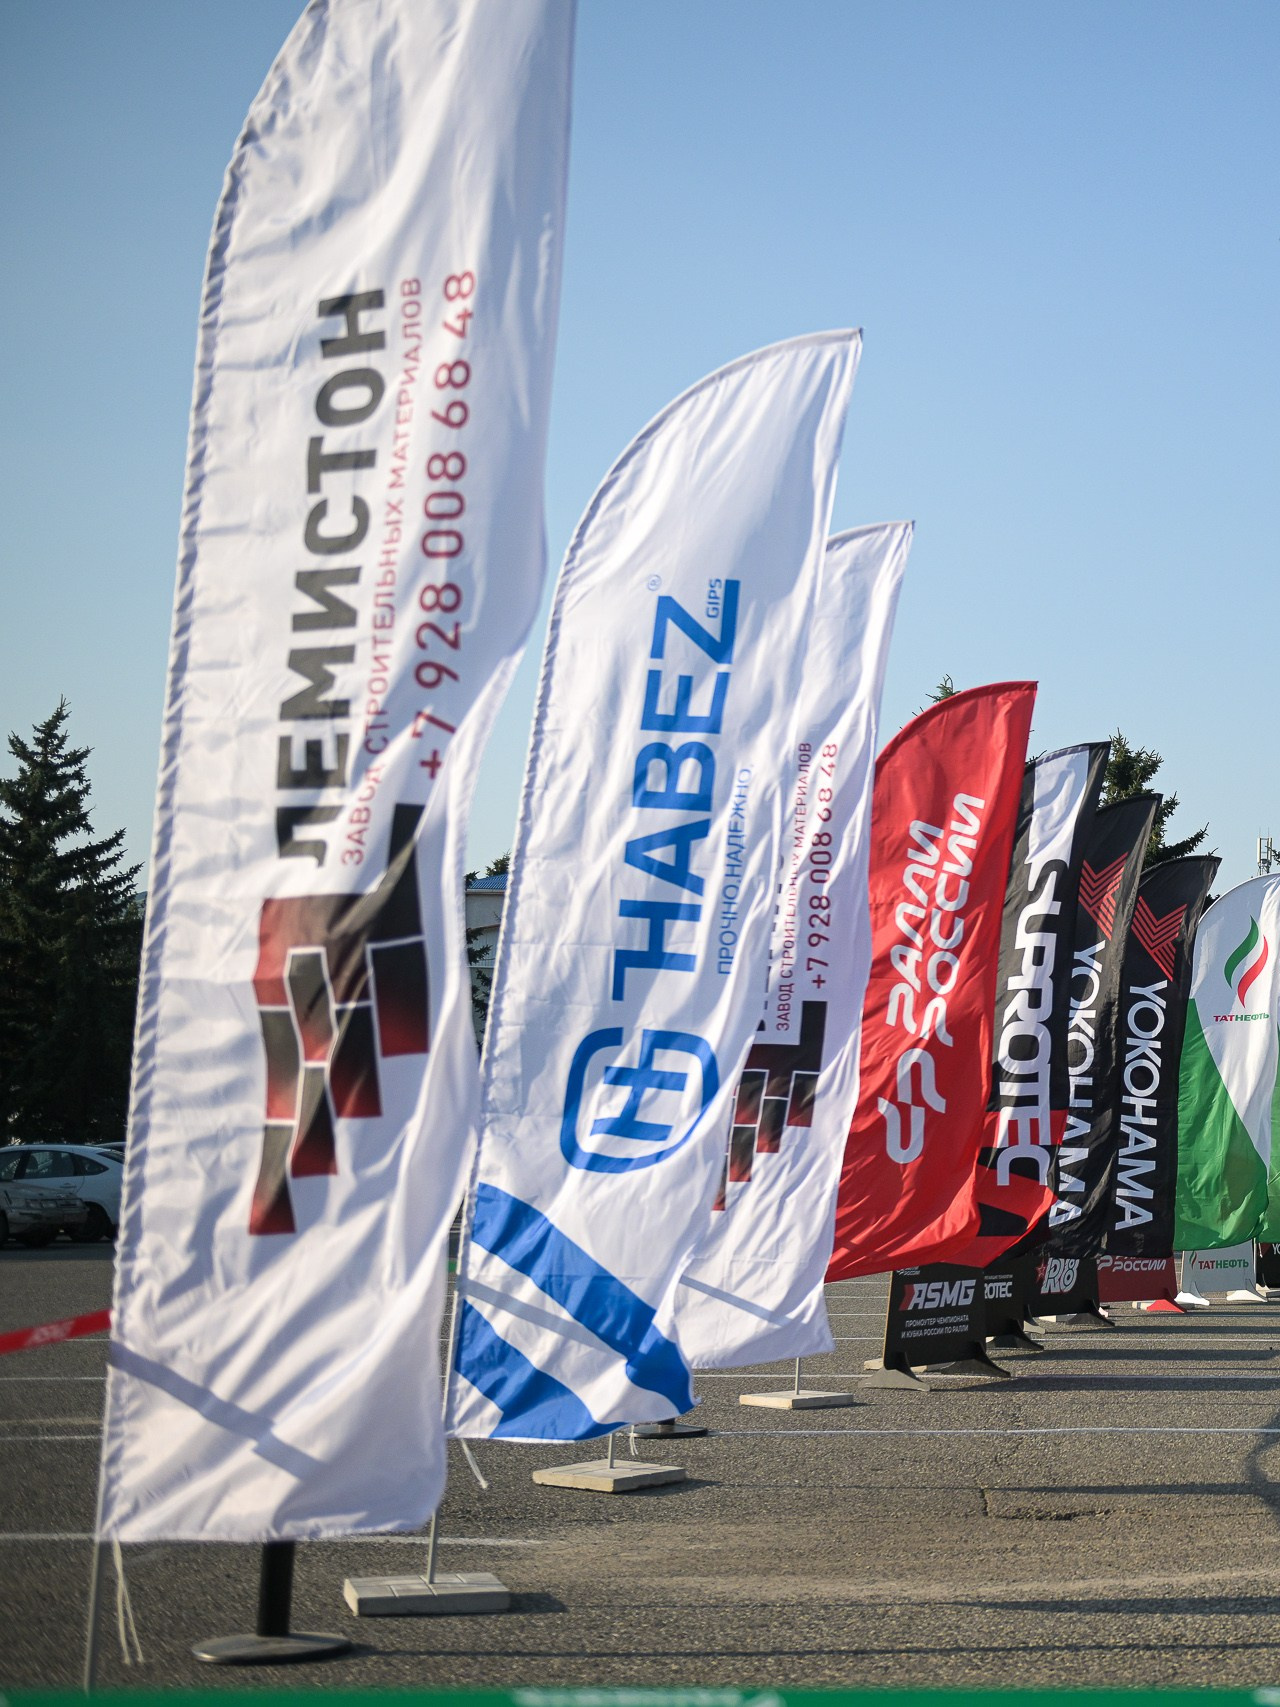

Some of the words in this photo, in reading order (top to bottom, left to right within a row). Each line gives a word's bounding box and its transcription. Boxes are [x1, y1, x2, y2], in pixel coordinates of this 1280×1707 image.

[443, 269, 476, 339] 48
[434, 358, 472, 430] 68
[421, 450, 468, 560] 008
[275, 288, 385, 868] ЛЕМИСТОН
[341, 763, 383, 866] ЗАВОД
[363, 503, 405, 754] СТРОИТЕЛЬНЫХ
[387, 277, 422, 491] МАТЕРИАЛОВ
[706, 578, 722, 619] GIPS
[414, 581, 464, 689] 928
[412, 711, 458, 780] +7
[820, 743, 838, 778] 48
[612, 578, 741, 1001] HABEZ
[776, 982, 794, 1031] ЗАВОД
[791, 742, 811, 848] МАТЕРИАЛОВ
[810, 831, 833, 884] 008
[808, 895, 831, 947] 928
[886, 819, 945, 1035] РАЛЛИ
[919, 792, 986, 1047] РОССИИ
[806, 956, 829, 989] +7
[1213, 1012, 1270, 1022] ТАТНЕФТЬ
[1115, 979, 1168, 1231] YOKOHAMA
[906, 1279, 977, 1311] ASMG
[984, 1281, 1013, 1300] ROTEC
[1112, 1259, 1167, 1272] РОССИИ
[1198, 1259, 1249, 1270] ТАТНЕФТЬ
[905, 1317, 937, 1328] ПРОМОУТЕР
[937, 1314, 969, 1324] ЧЕМПИОНАТА
[906, 1329, 923, 1338] КУБКА
[924, 1327, 944, 1336] РОССИИ
[944, 1326, 952, 1334] ПО
[952, 1324, 969, 1333] РАЛЛИ
